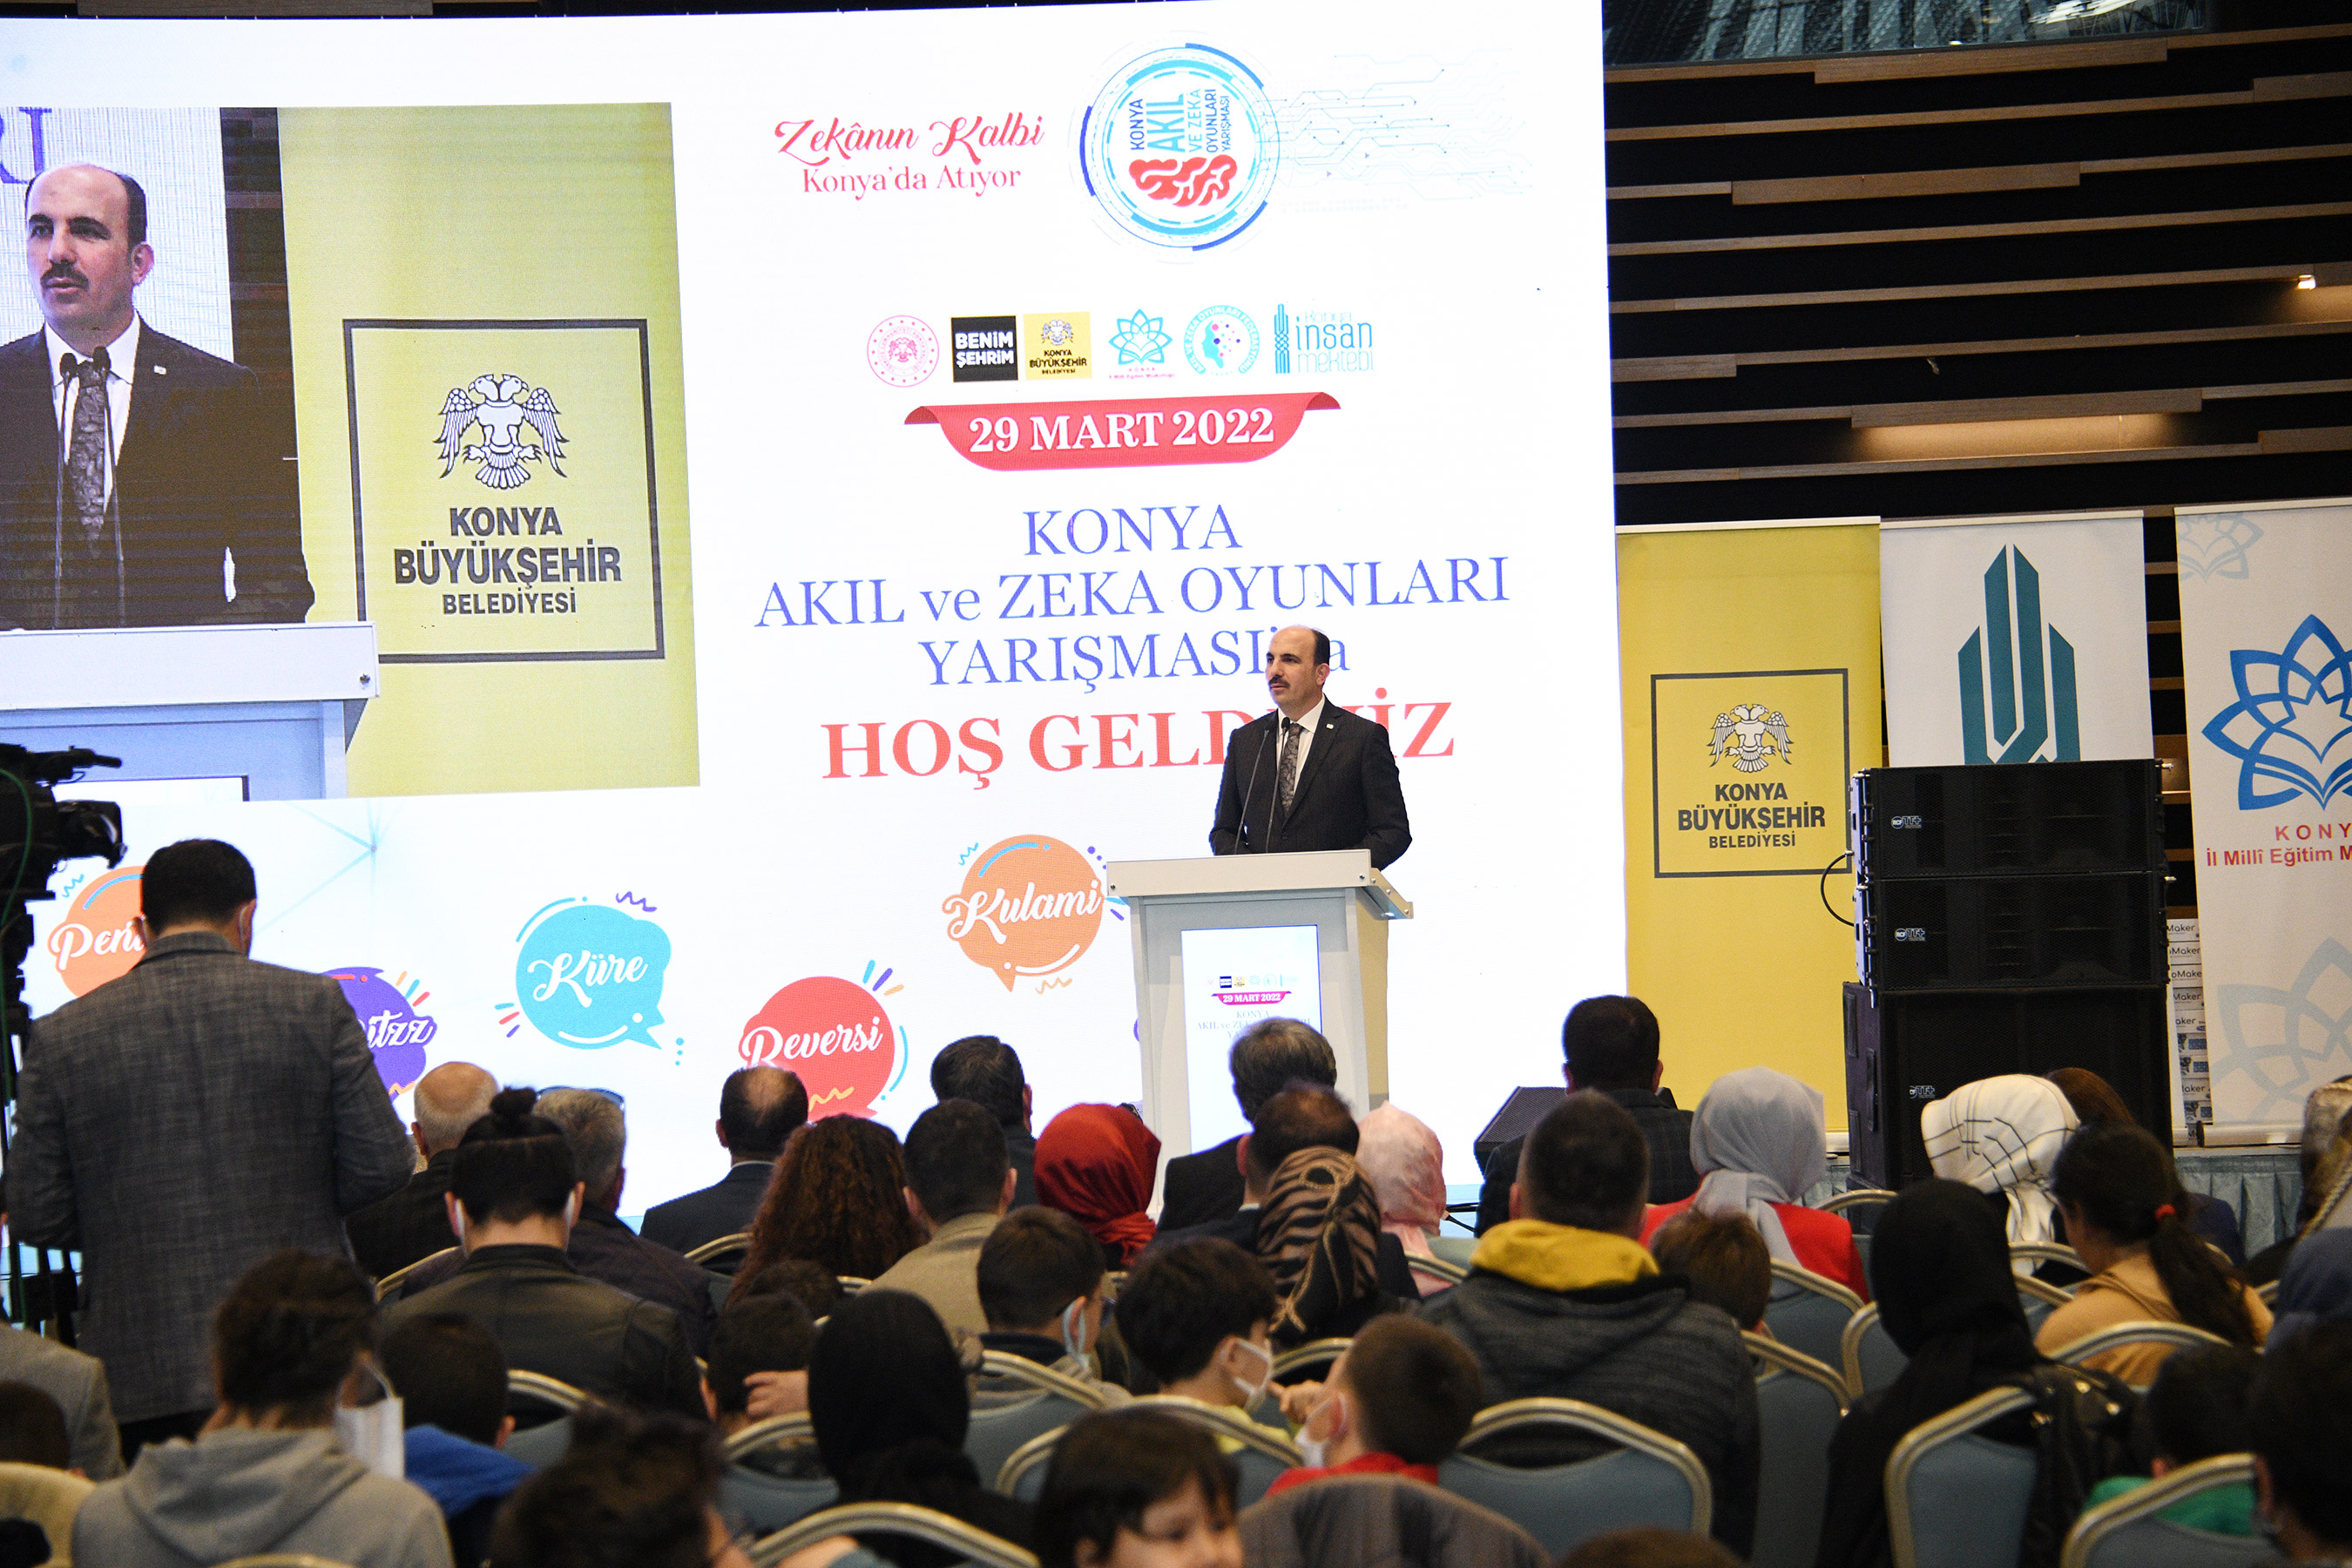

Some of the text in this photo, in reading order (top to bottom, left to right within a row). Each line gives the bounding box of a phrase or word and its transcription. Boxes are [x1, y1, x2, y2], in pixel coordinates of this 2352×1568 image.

[774, 112, 1044, 166] Zekânın Kalbi
[1129, 98, 1146, 151] KONYA
[1146, 93, 1186, 153] AKIL
[1186, 88, 1203, 153] VE ZEKA
[1205, 89, 1219, 153] OYUNLARI
[802, 165, 1022, 201] Konya'da Atıyor
[955, 330, 1014, 349] BENİM
[956, 349, 1015, 368] ŞEHRİM
[1295, 316, 1373, 350] insan
[970, 408, 1274, 452] 29 MART 2022
[449, 507, 563, 537] KONYA
[1023, 504, 1243, 556] KONYA
[394, 538, 622, 590] BÜYÜKŞEHİR
[442, 587, 577, 615] BELEDİYESİ
[754, 556, 1511, 627] AKIL ve ZEKA OYUNLARI
[917, 625, 1350, 694] YARIŞMASI'a
[821, 717, 1004, 790] HOŞ
[1678, 801, 1826, 832] BÜYÜKŞEHİR
[1715, 782, 1788, 801] KONYA
[1709, 830, 1796, 848] BELEDİYESİ
[2207, 848, 2218, 867] İl
[2224, 849, 2264, 866] Millî
[2270, 847, 2333, 867] Eğitim
[2275, 823, 2352, 841] KONY
[944, 873, 1102, 944] Kulami
[527, 950, 649, 1008] Küre
[741, 1016, 883, 1068] Reversi
